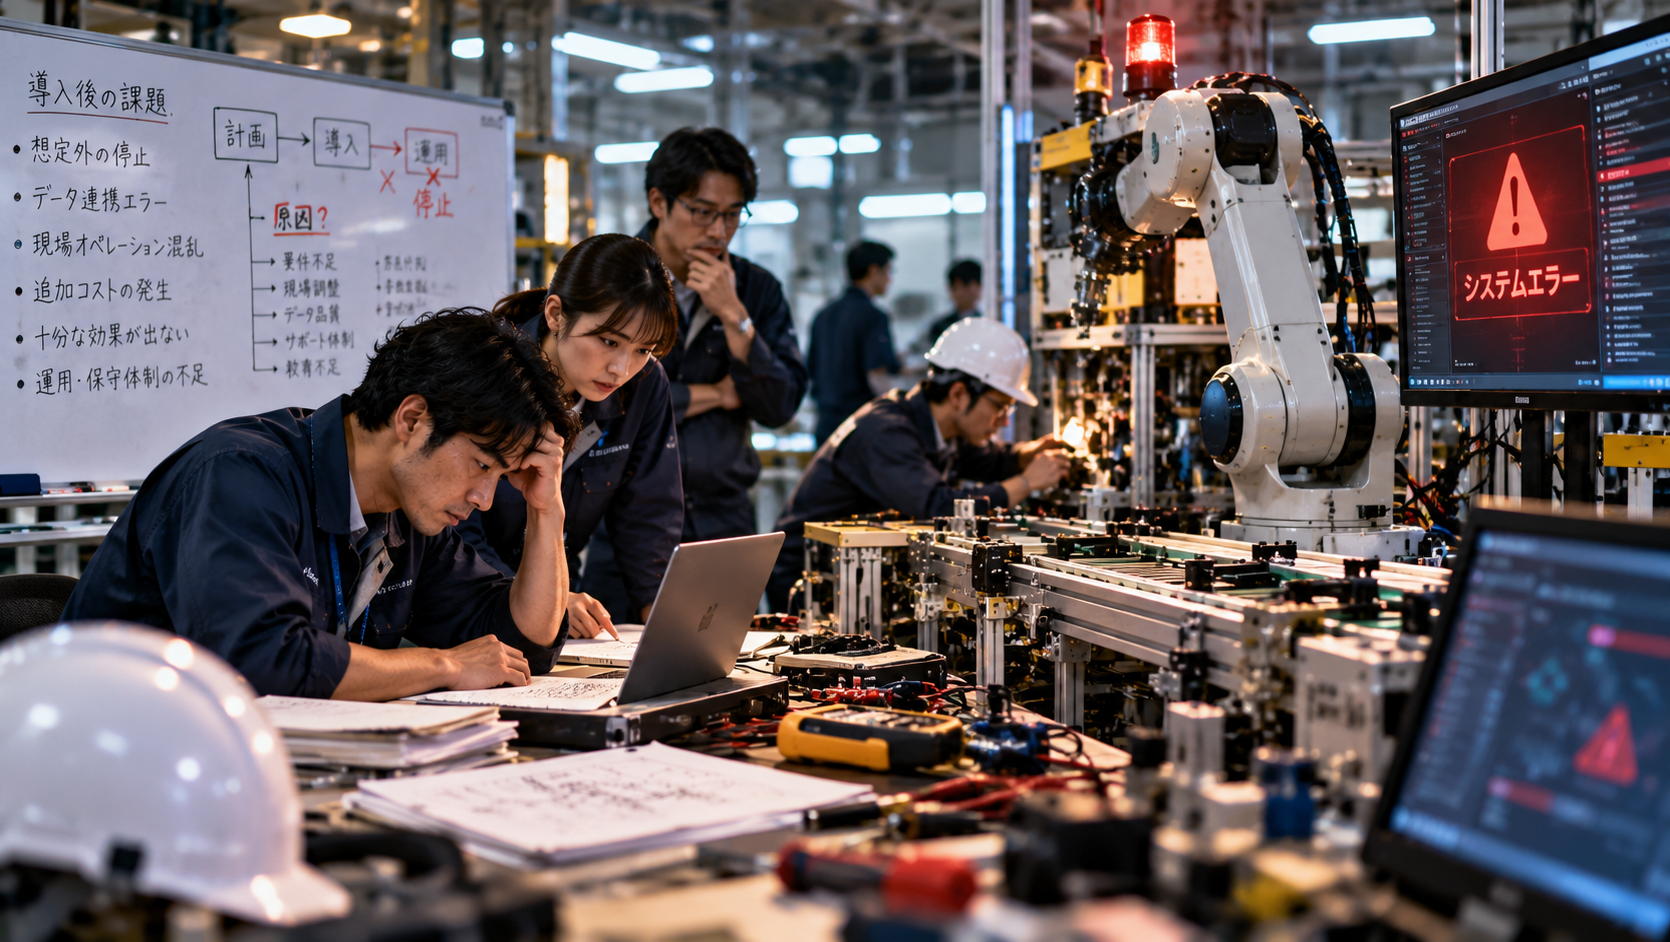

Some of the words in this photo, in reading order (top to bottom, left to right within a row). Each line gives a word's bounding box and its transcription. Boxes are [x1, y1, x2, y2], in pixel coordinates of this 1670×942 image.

[225, 119, 265, 149] 計画
[325, 129, 359, 157] 導入
[31, 135, 151, 168] 想定外の停止
[414, 138, 448, 166] 運用
[33, 184, 167, 213] データ連携エラー
[413, 188, 454, 219] 停止
[33, 231, 204, 258] 現場オペレーション混乱
[34, 276, 172, 303] 追加コストの発生
[284, 278, 340, 299] 現場調整
[1464, 265, 1580, 302] システムエラー
[34, 323, 189, 351] 十分な効果が出ない
[285, 330, 354, 350] サポート体制
